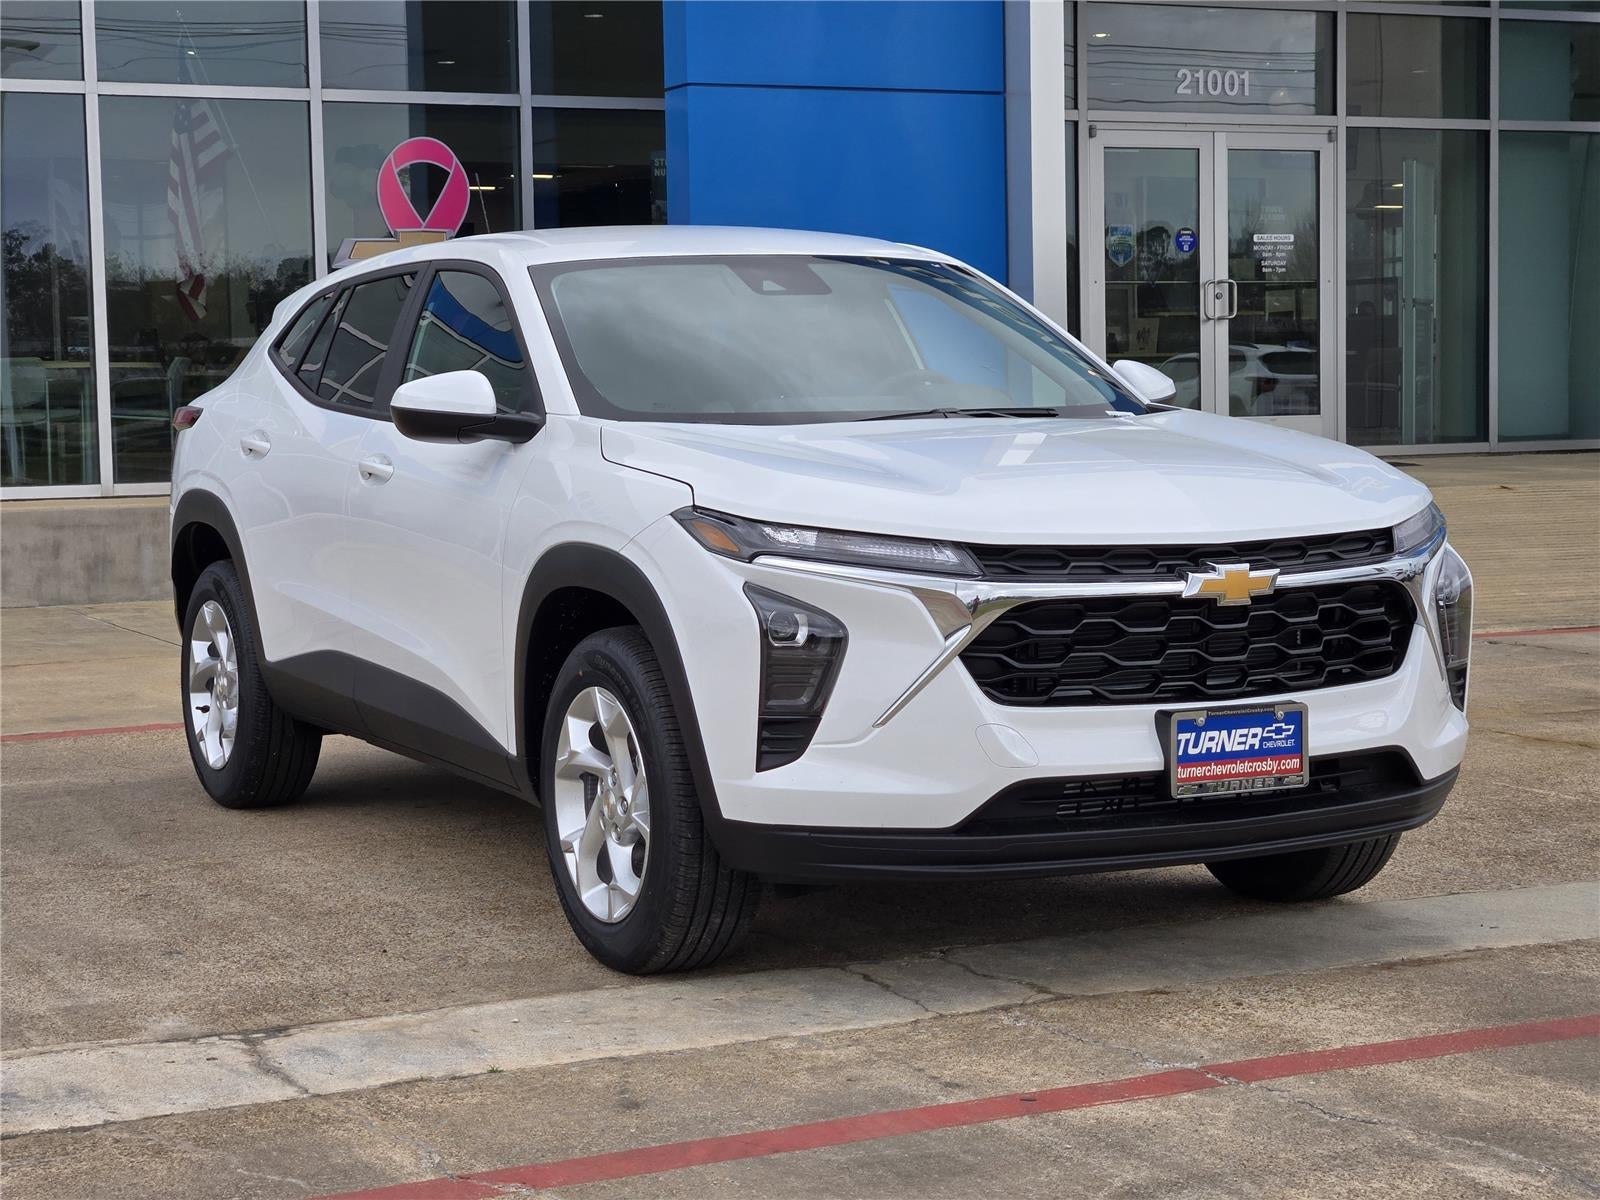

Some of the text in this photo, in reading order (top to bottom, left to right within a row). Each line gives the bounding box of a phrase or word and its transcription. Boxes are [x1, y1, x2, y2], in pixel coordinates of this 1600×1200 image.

[1176, 68, 1250, 96] 21001
[654, 158, 668, 167] ST
[1178, 727, 1263, 756] TURNER
[1263, 738, 1295, 749] CHEVROLET
[1177, 757, 1300, 779] turnerchevroletcrosby.com
[1206, 777, 1275, 793] TURNER
